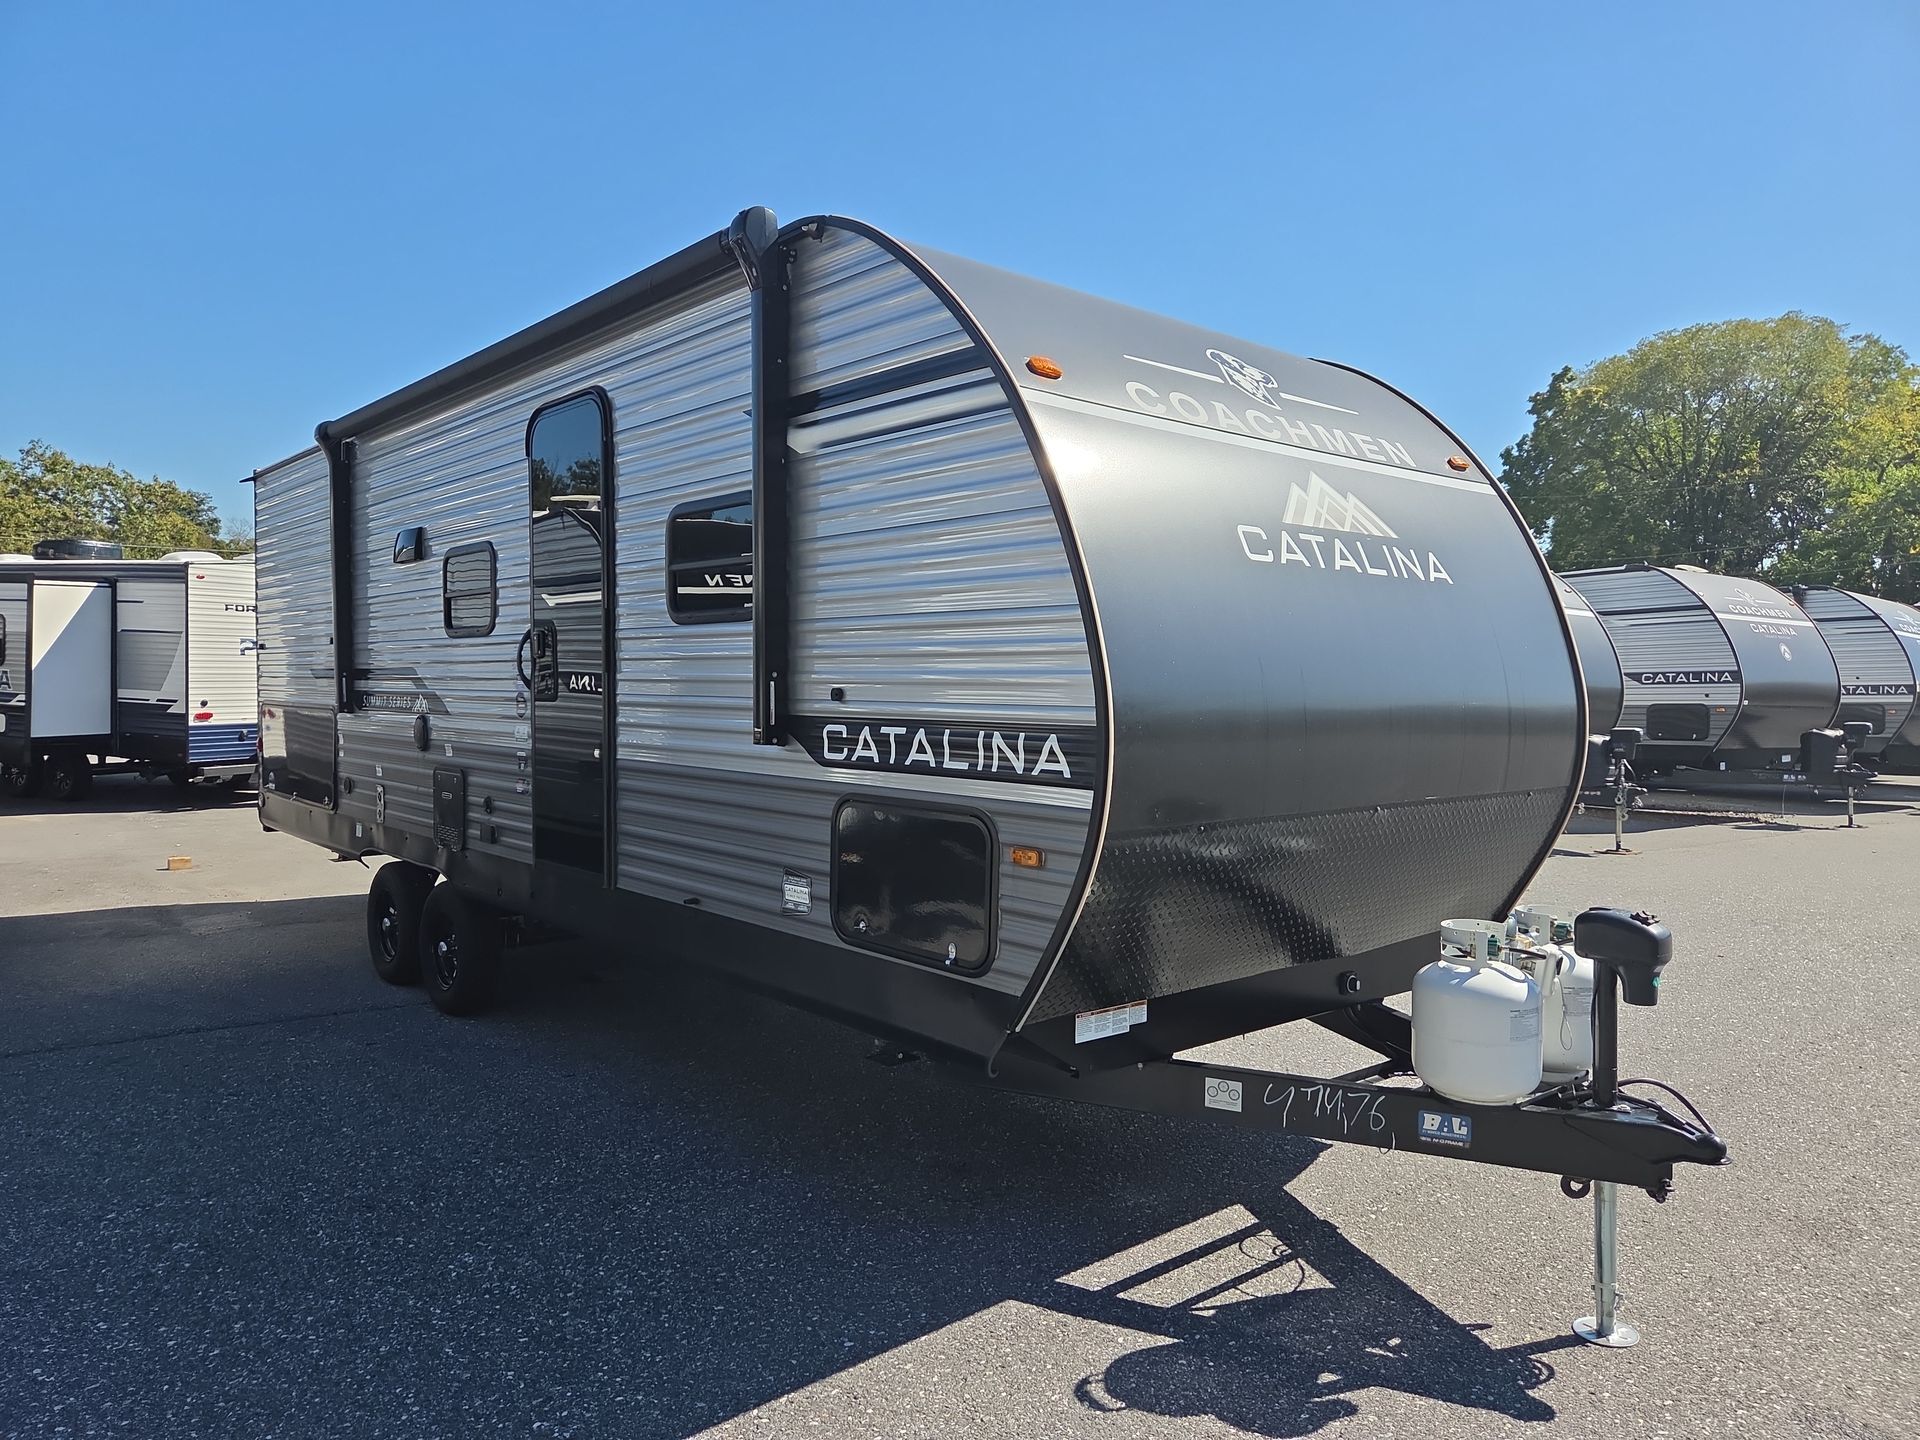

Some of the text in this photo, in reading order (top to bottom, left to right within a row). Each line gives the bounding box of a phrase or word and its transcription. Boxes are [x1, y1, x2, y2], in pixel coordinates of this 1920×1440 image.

[1125, 381, 1417, 467] COACHMEN
[1237, 525, 1454, 584] CATALINA
[1728, 604, 1792, 618] COACHMEN
[1749, 623, 1798, 636] CATALINA
[1641, 671, 1734, 684] CATALINA
[362, 695, 411, 708] SUMMIT SERIES
[822, 724, 1072, 779] CATALINA
